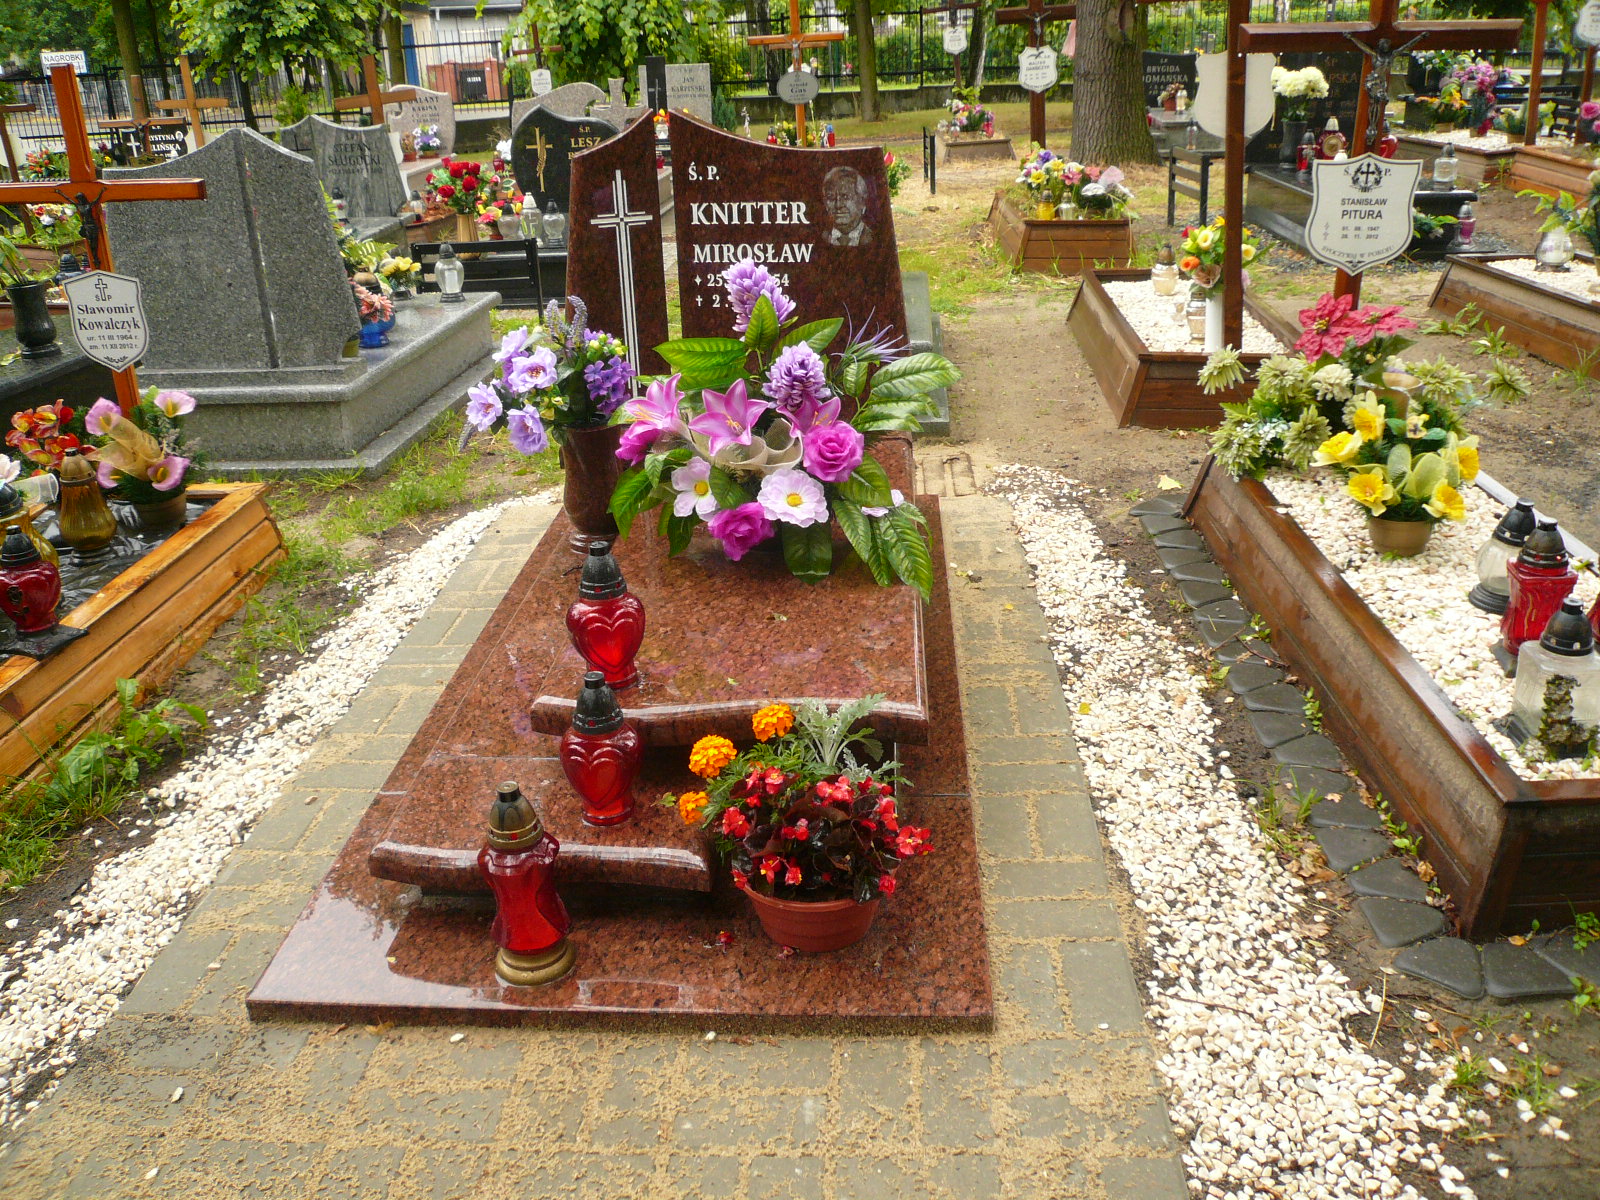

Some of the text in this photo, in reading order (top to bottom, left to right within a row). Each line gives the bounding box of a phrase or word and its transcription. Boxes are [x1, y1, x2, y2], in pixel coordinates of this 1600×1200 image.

[43, 54, 83, 62] NAGROBKI
[1146, 65, 1180, 73] BRYGIDA
[1340, 198, 1388, 206] STANISŁAW
[690, 201, 810, 225] KNITTER
[1340, 210, 1383, 220] PITURA
[692, 243, 814, 263] MIROSŁAW
[77, 304, 135, 315] Sławomir
[77, 317, 141, 333] Kowalczyk
